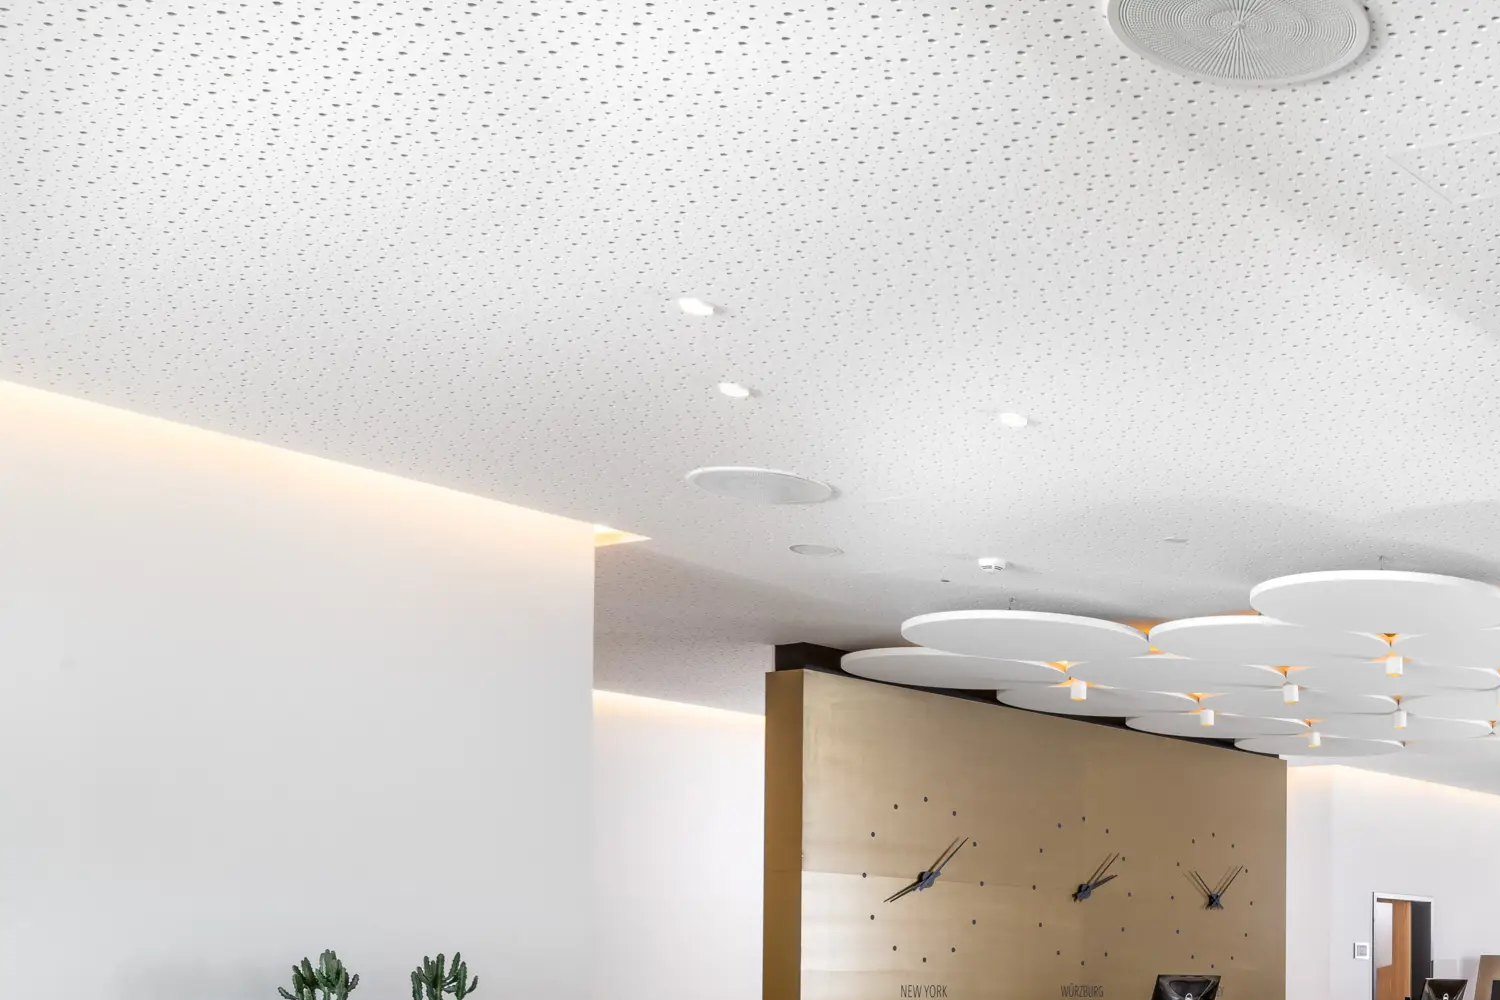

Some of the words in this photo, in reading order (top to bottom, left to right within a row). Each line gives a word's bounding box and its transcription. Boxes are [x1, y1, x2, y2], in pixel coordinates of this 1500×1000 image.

[900, 984, 922, 998] NEW
[923, 984, 948, 998] YORK
[1060, 982, 1104, 998] WÜRZBURG
